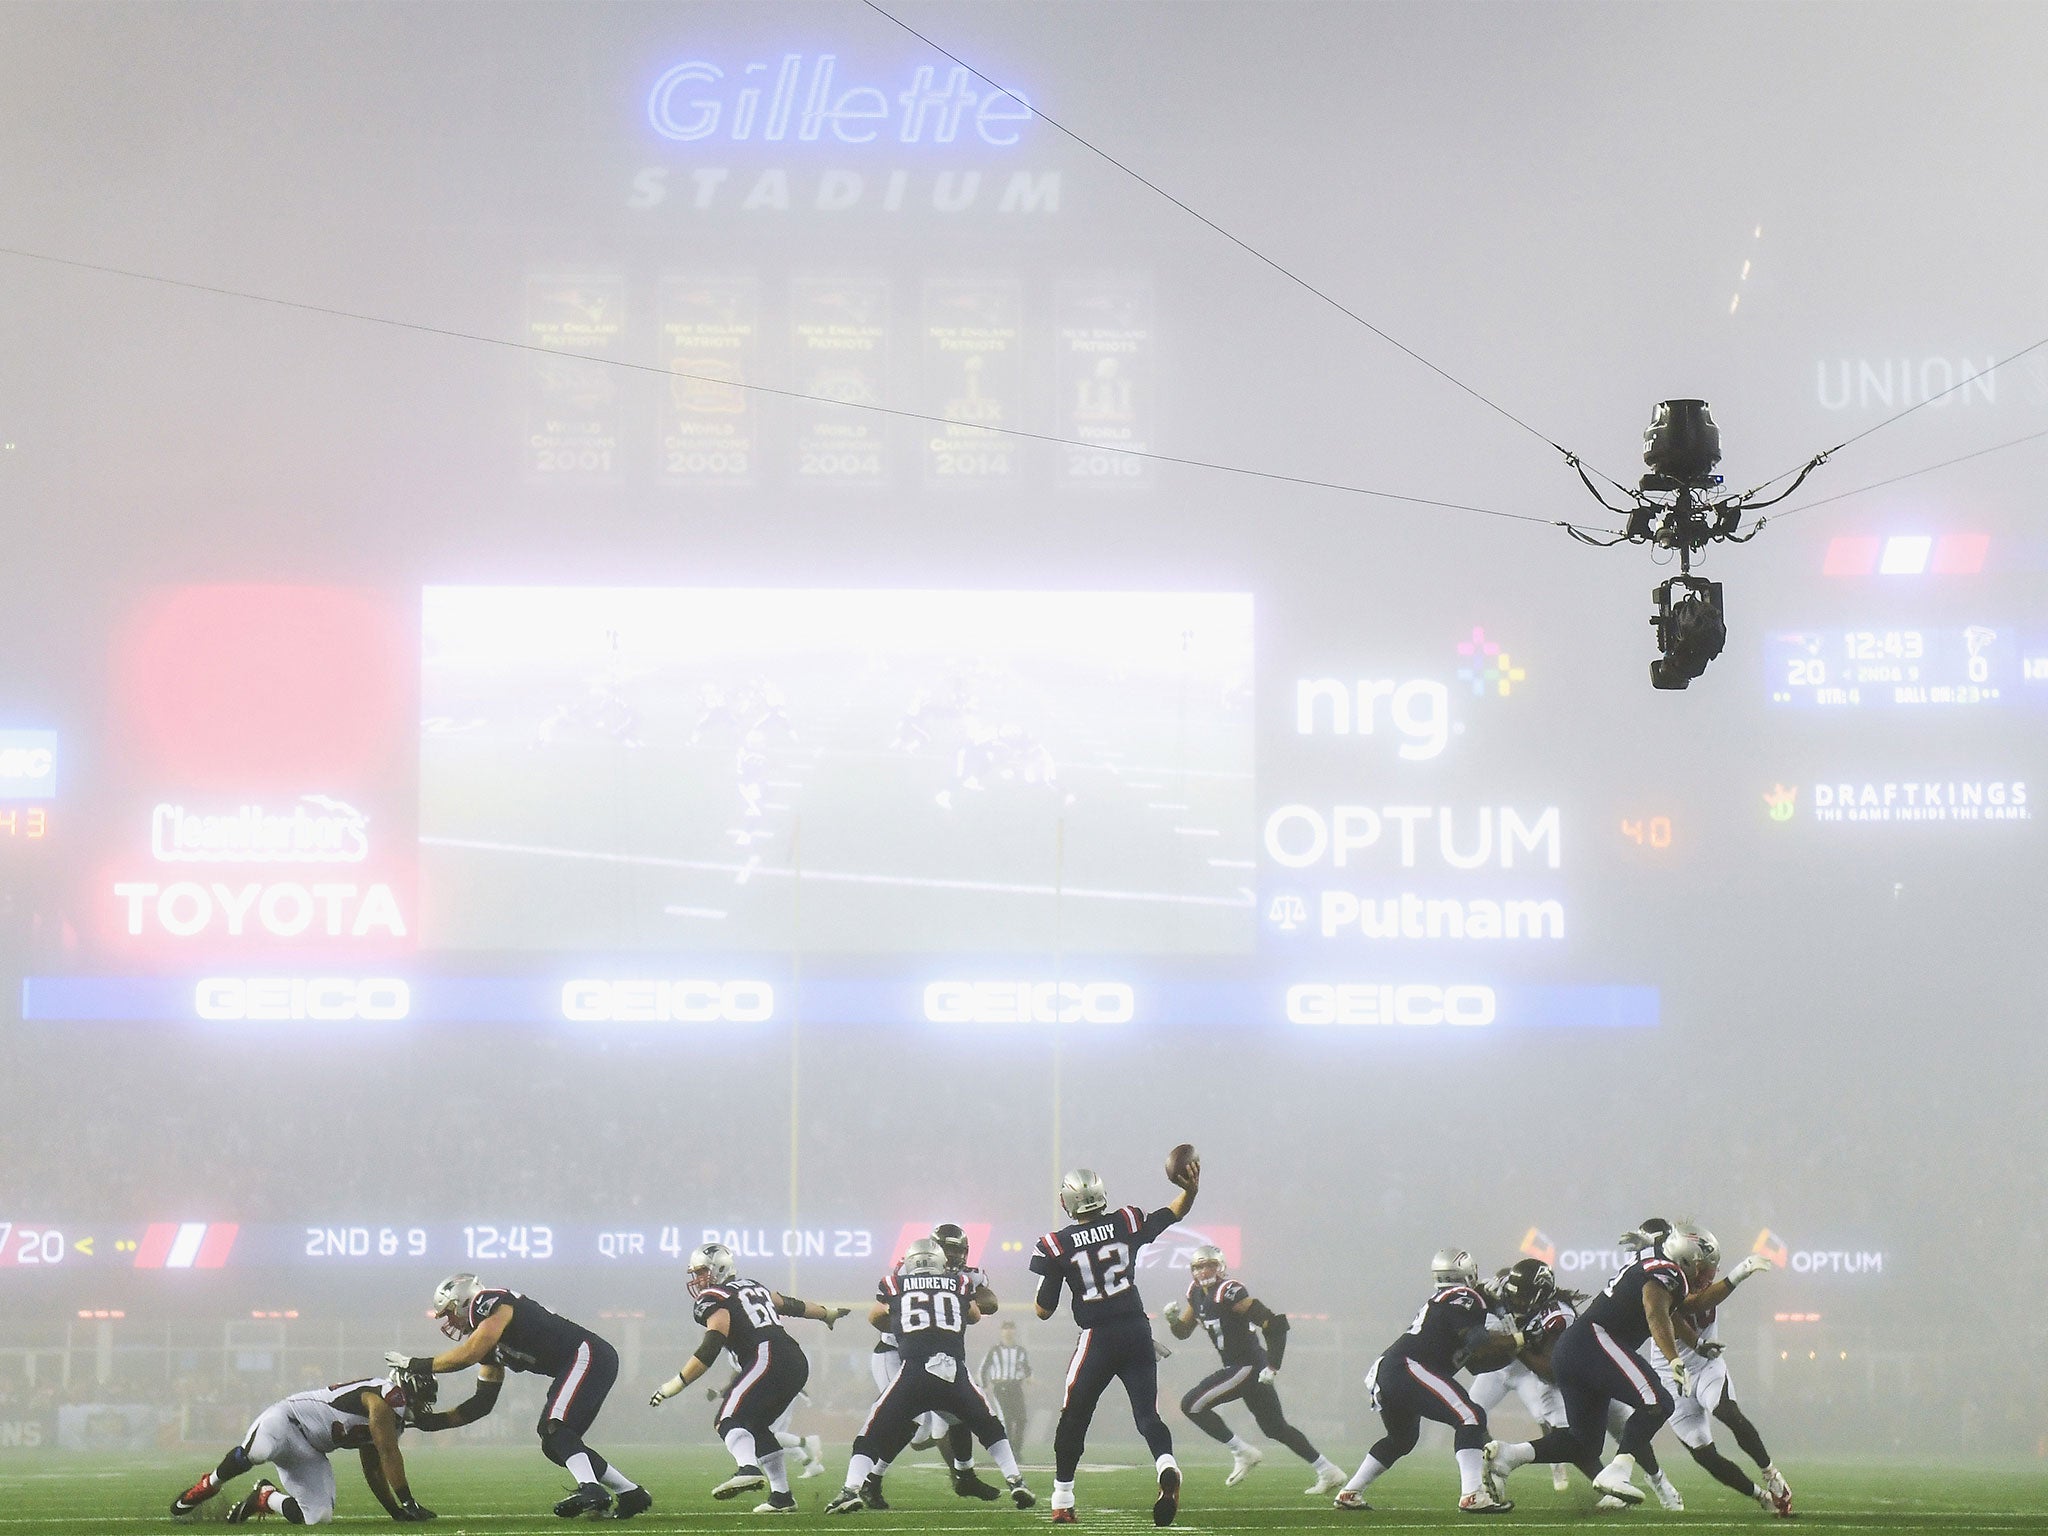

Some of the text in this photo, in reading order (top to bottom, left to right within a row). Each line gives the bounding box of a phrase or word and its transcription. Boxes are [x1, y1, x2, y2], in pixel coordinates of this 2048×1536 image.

[647, 54, 1033, 146] Gillette
[627, 165, 1063, 213] STADIUM
[1816, 355, 1998, 411] UNION
[536, 450, 611, 472] 2001
[666, 451, 748, 473] 2003
[799, 453, 881, 474] 2004
[935, 452, 1009, 475] 2014
[1068, 456, 1143, 477] 2016
[1844, 631, 1924, 659] 12:43
[1788, 659, 1826, 685] 20
[1967, 656, 1989, 682] 0
[1297, 677, 1449, 761] nrg
[1815, 781, 2027, 807] DRAFTKINGS
[1815, 808, 1843, 821] THE
[1849, 808, 1890, 821] GAME
[1896, 808, 1946, 821] INSIDE
[1951, 807, 1979, 820] THE
[1263, 804, 1562, 869] OPTUM
[1621, 816, 1672, 849] 40
[113, 881, 408, 937] TOYOTA
[1320, 889, 1566, 940] Putnam
[195, 977, 411, 1021] GEICO
[561, 979, 774, 1022] GEICO
[923, 982, 1135, 1024] GEICO
[1286, 983, 1496, 1026] GEICO
[17, 1229, 65, 1264] 20
[305, 1228, 427, 1257] 2ND & 9
[463, 1225, 554, 1259] 12:43
[598, 1226, 682, 1258] QTR 4
[782, 1230, 826, 1257] ON
[833, 1230, 872, 1257] 23
[1070, 1223, 1117, 1248] BRADY
[1070, 1242, 1131, 1302] 12
[1559, 1250, 1635, 1273] OPTU
[1791, 1250, 1884, 1274] OPTUM
[903, 1276, 957, 1292] ANDREWS
[900, 1291, 963, 1334] 60
